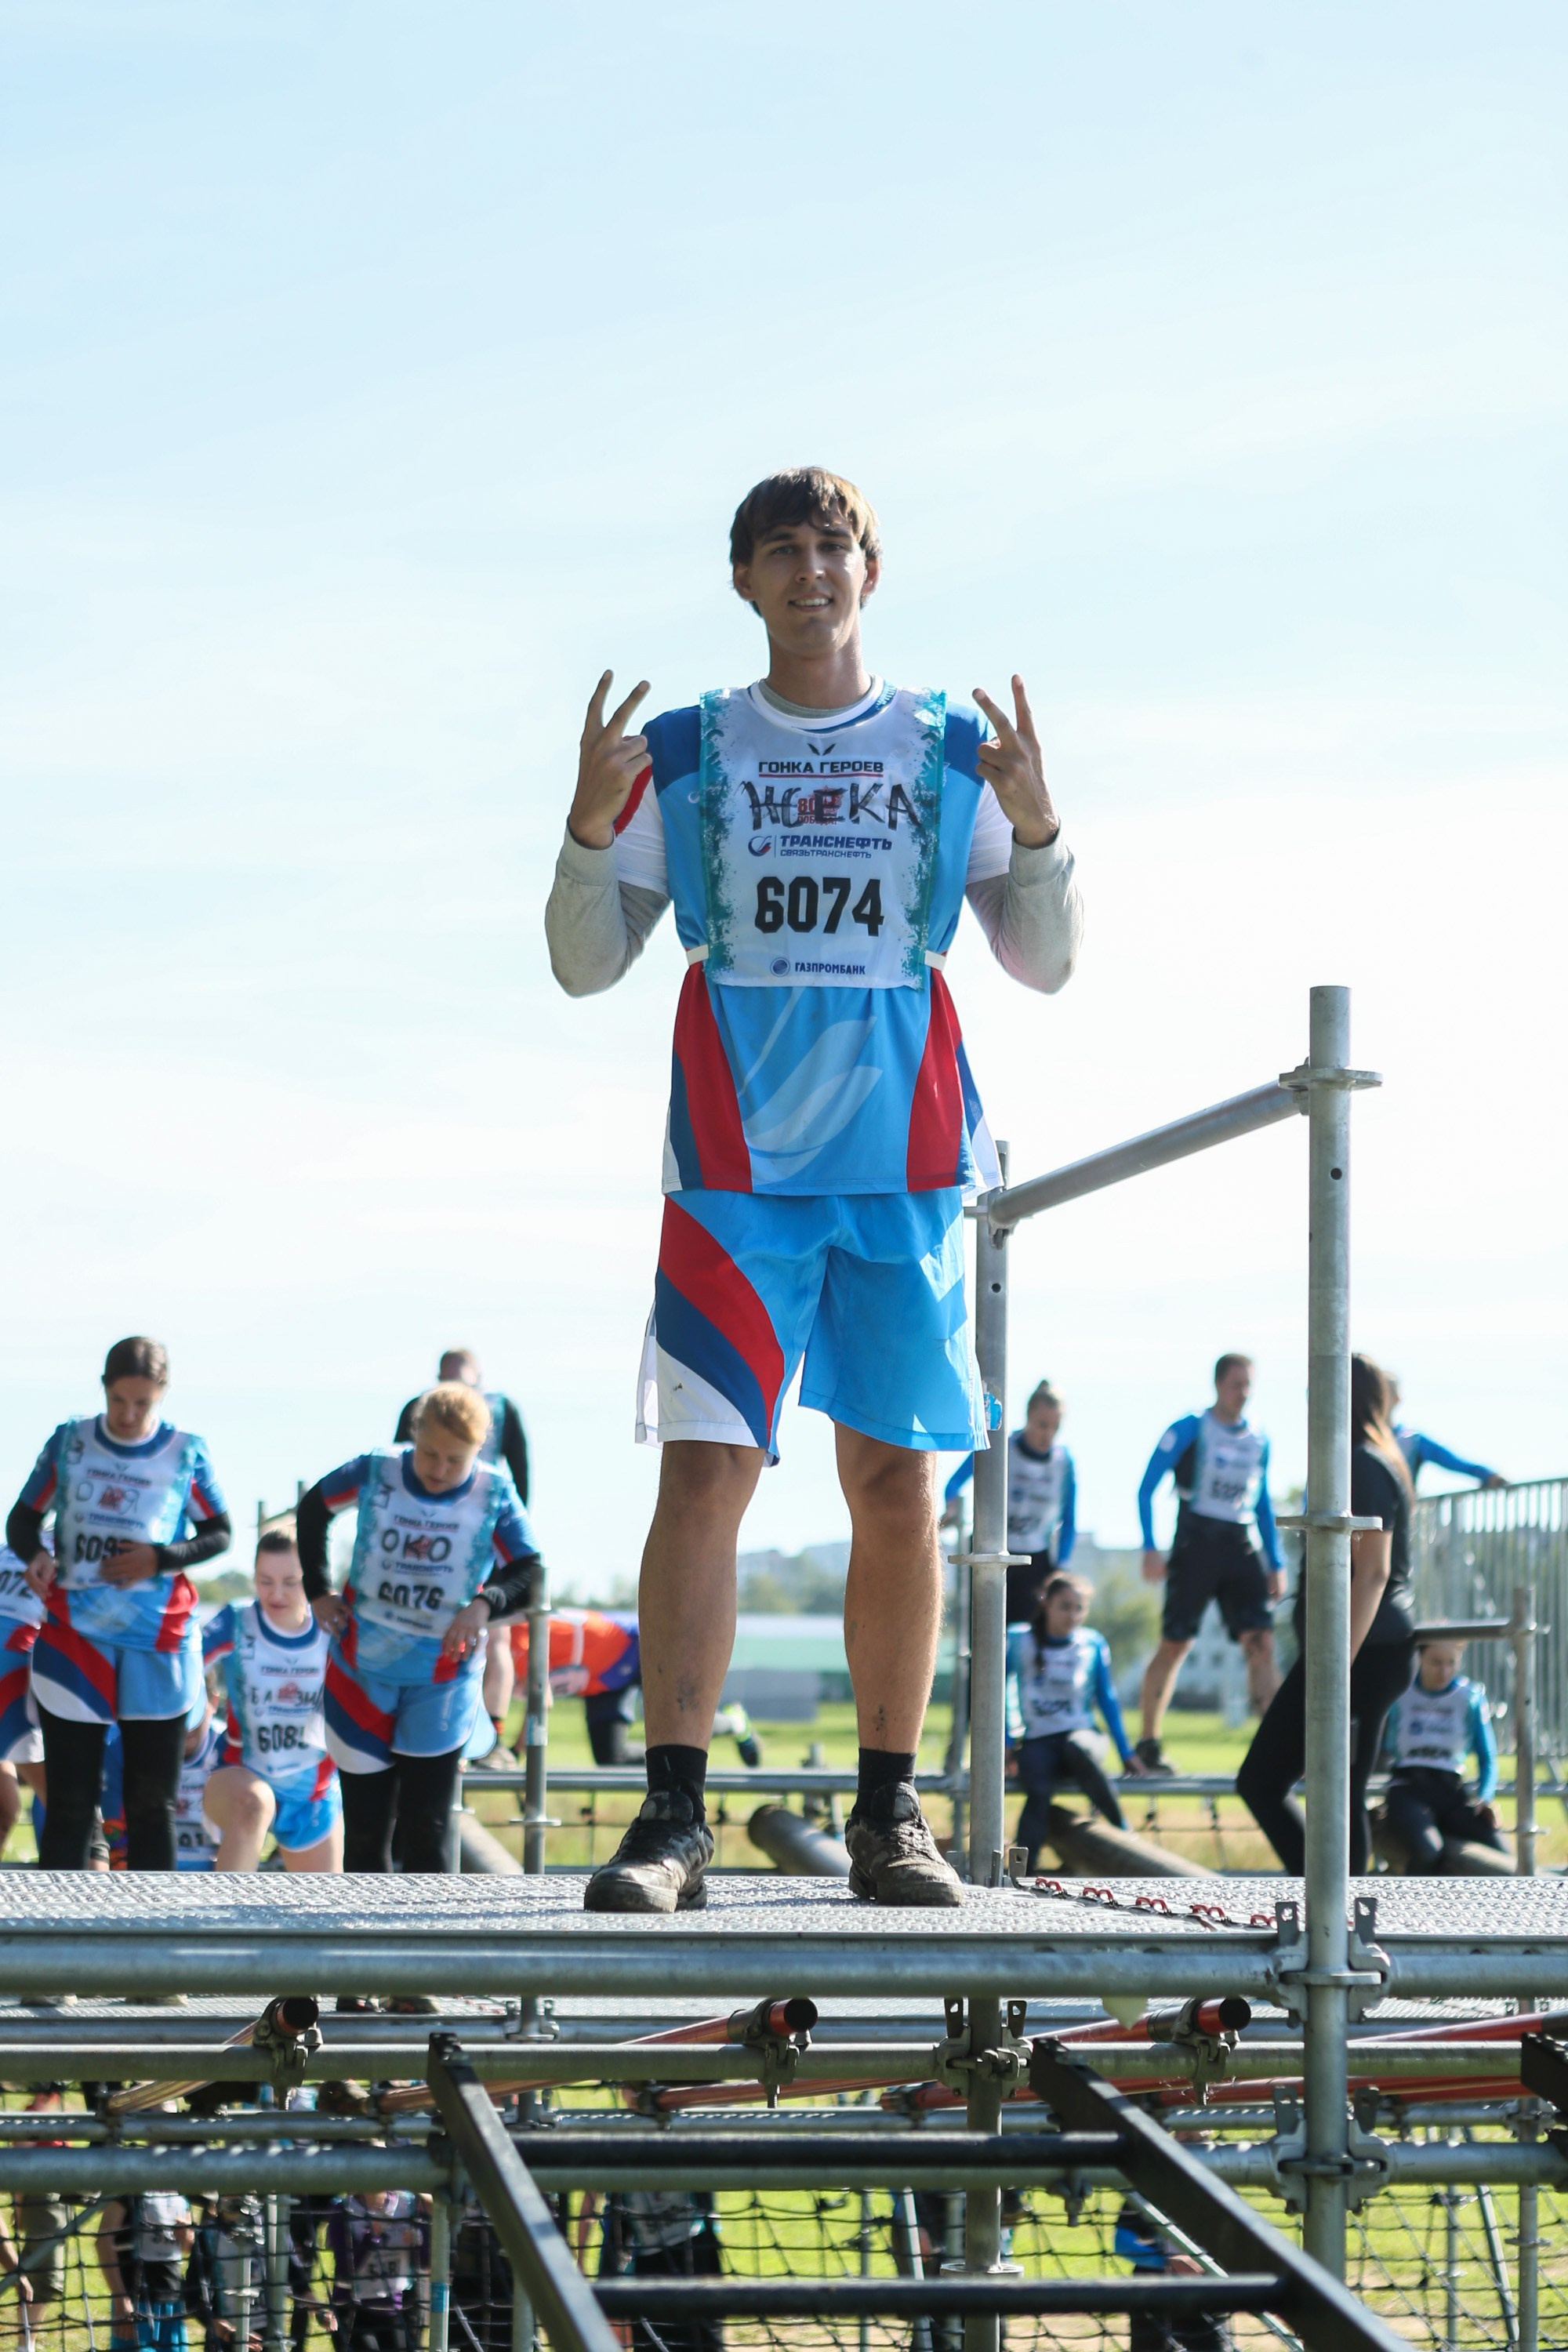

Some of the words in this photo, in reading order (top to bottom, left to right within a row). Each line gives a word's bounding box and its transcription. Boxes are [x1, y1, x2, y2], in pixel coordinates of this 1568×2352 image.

[759, 760, 814, 773] ГОНКА
[820, 760, 884, 773] ГЕРОЕВ
[780, 835, 892, 851] ТРАНСНЕФТЬ
[780, 848, 872, 859] СВЯЗЬТРАНСНЕФТЬ
[754, 877, 884, 937] 6074
[795, 961, 866, 975] ГАЗПРОМБАНК
[381, 1529, 452, 1563] ОКО
[378, 1581, 445, 1610] 6076
